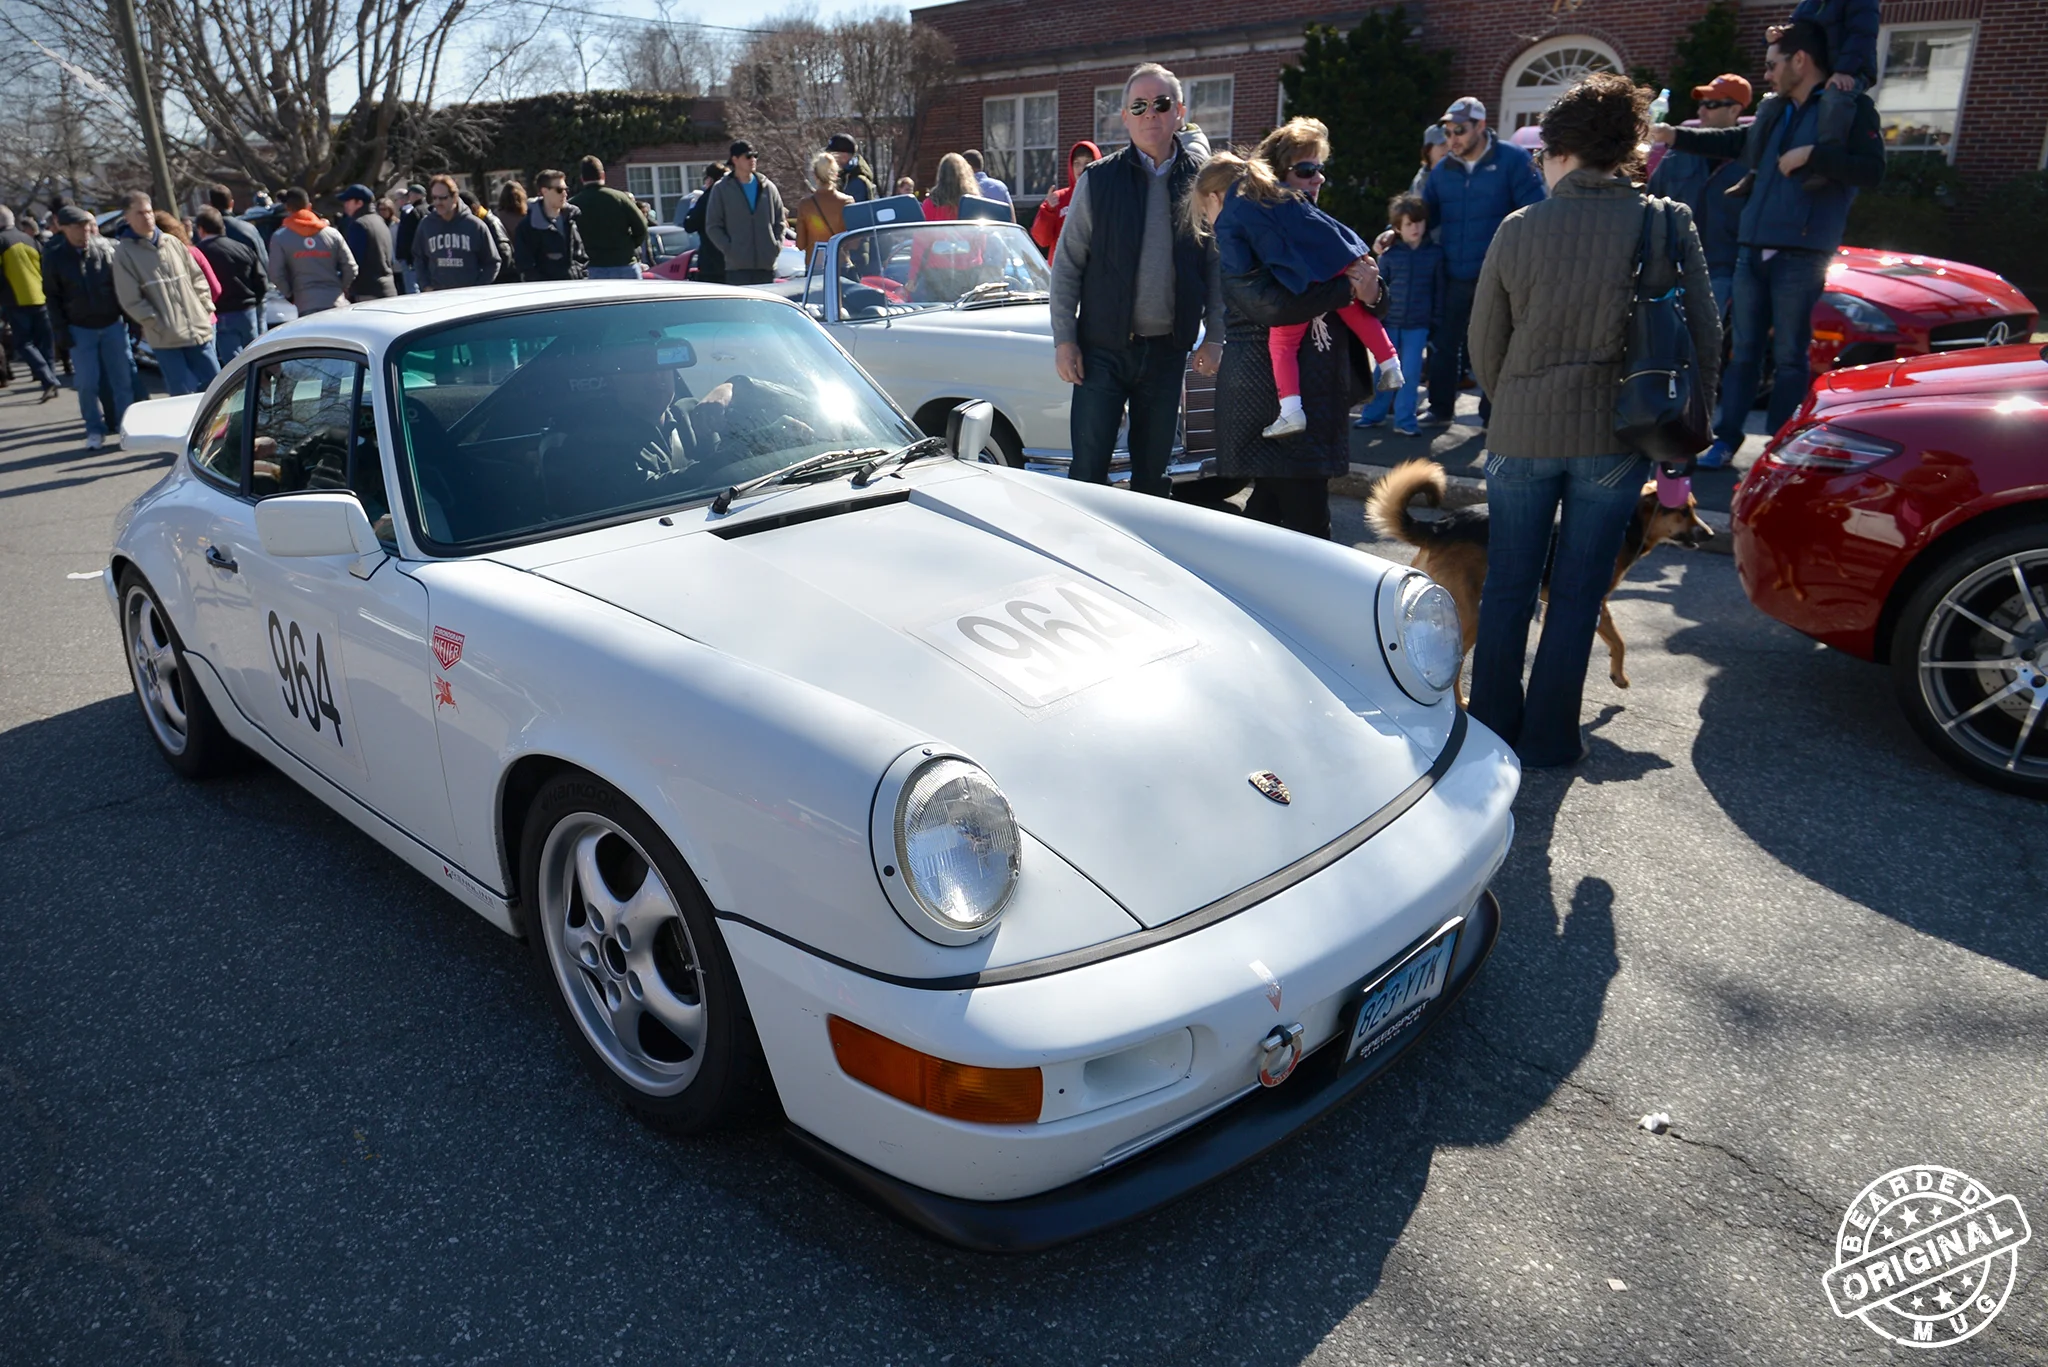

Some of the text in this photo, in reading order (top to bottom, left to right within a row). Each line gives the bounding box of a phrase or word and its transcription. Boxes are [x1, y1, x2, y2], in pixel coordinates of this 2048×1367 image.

[429, 233, 471, 252] UCONN
[437, 258, 464, 267] HUSKIES
[434, 637, 460, 664] HEUER
[957, 586, 1136, 682] 964
[268, 610, 343, 747] 964
[1360, 997, 1430, 1056] SPEEDSPORT
